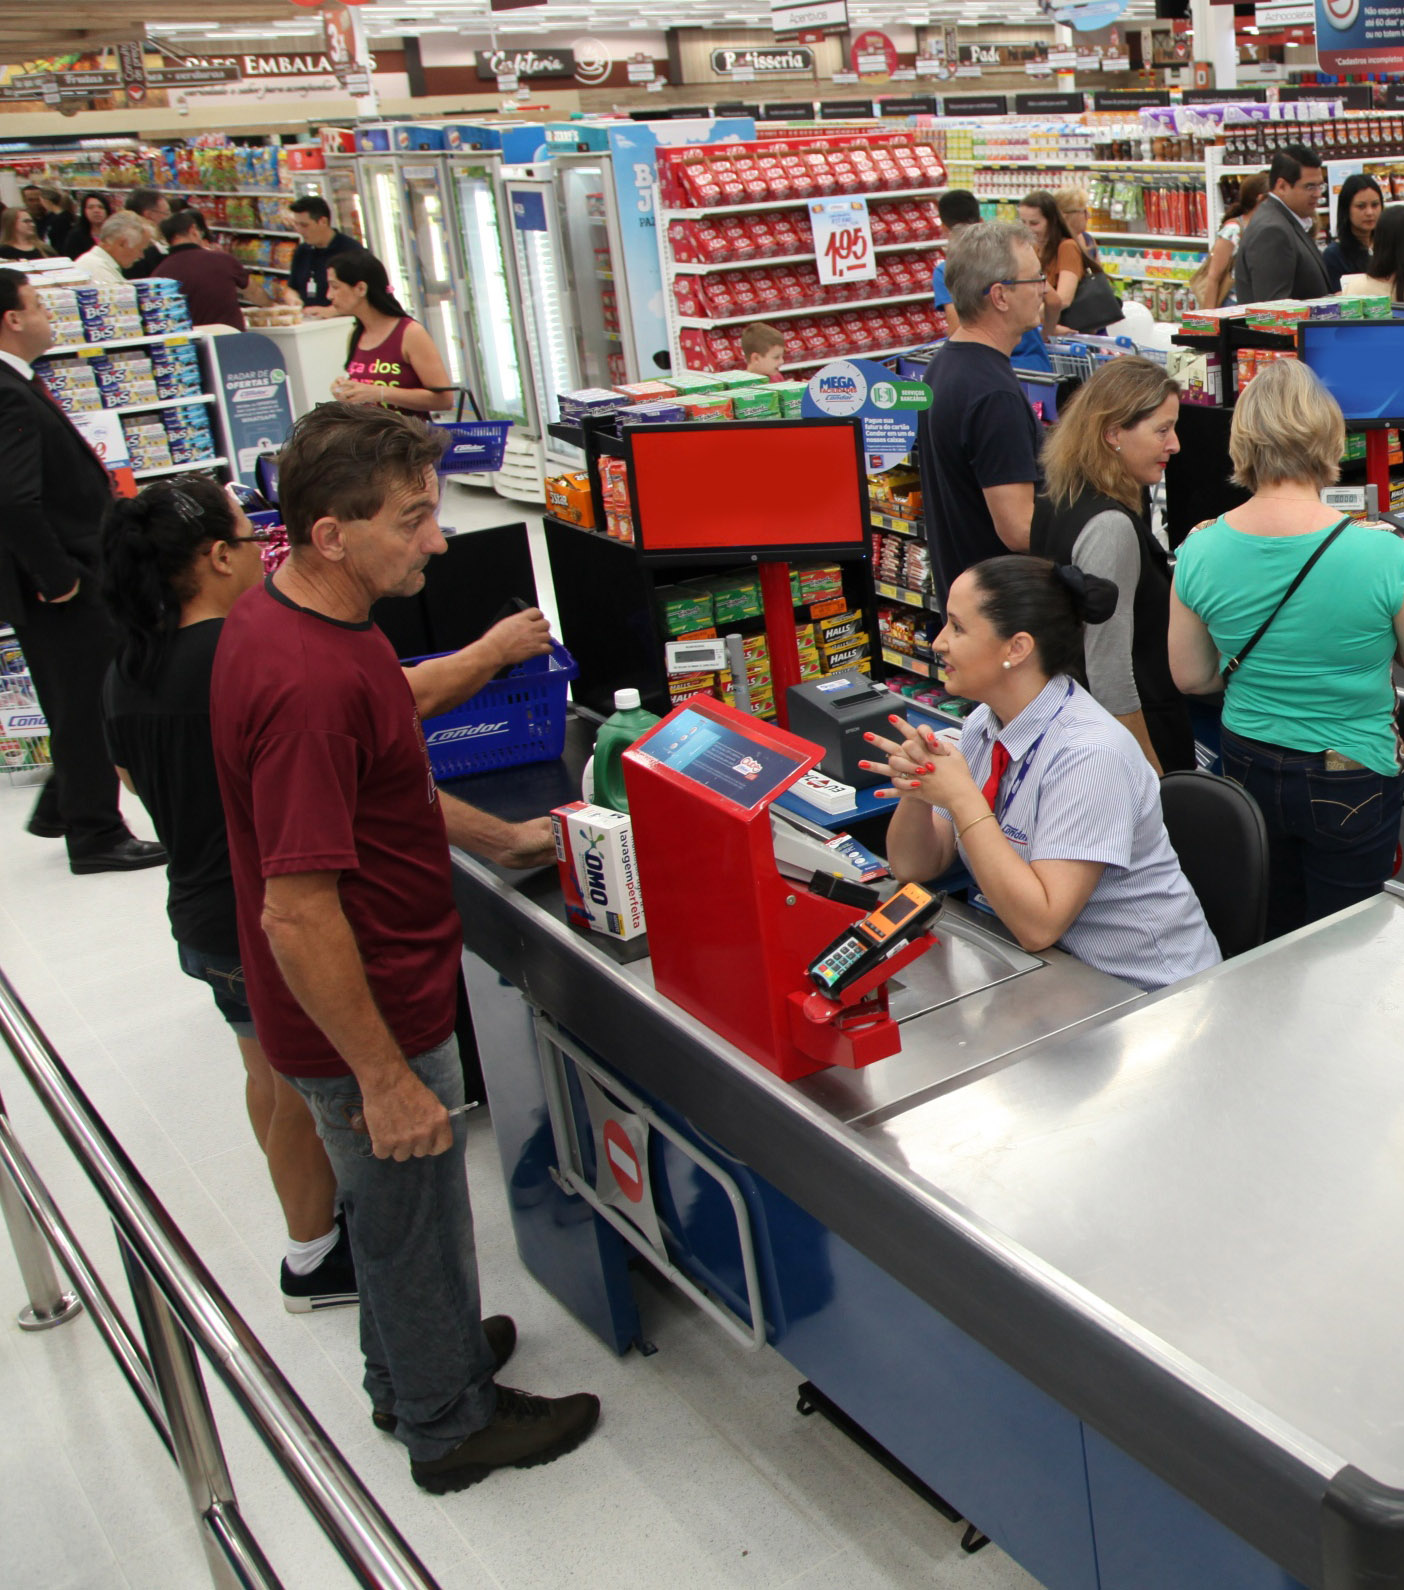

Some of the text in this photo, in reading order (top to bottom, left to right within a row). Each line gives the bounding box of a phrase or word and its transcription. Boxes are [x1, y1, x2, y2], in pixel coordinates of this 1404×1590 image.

[242, 53, 377, 74] EMBALAS
[723, 51, 803, 70] Ptisseria
[368, 359, 401, 375] dos
[226, 378, 269, 390] OFERTAS
[227, 370, 269, 382] RADAR DE
[818, 376, 856, 388] MEGA
[825, 623, 850, 639] HALLS
[831, 649, 857, 665] HALLS
[428, 721, 509, 745] Condor
[585, 853, 608, 906] OMO
